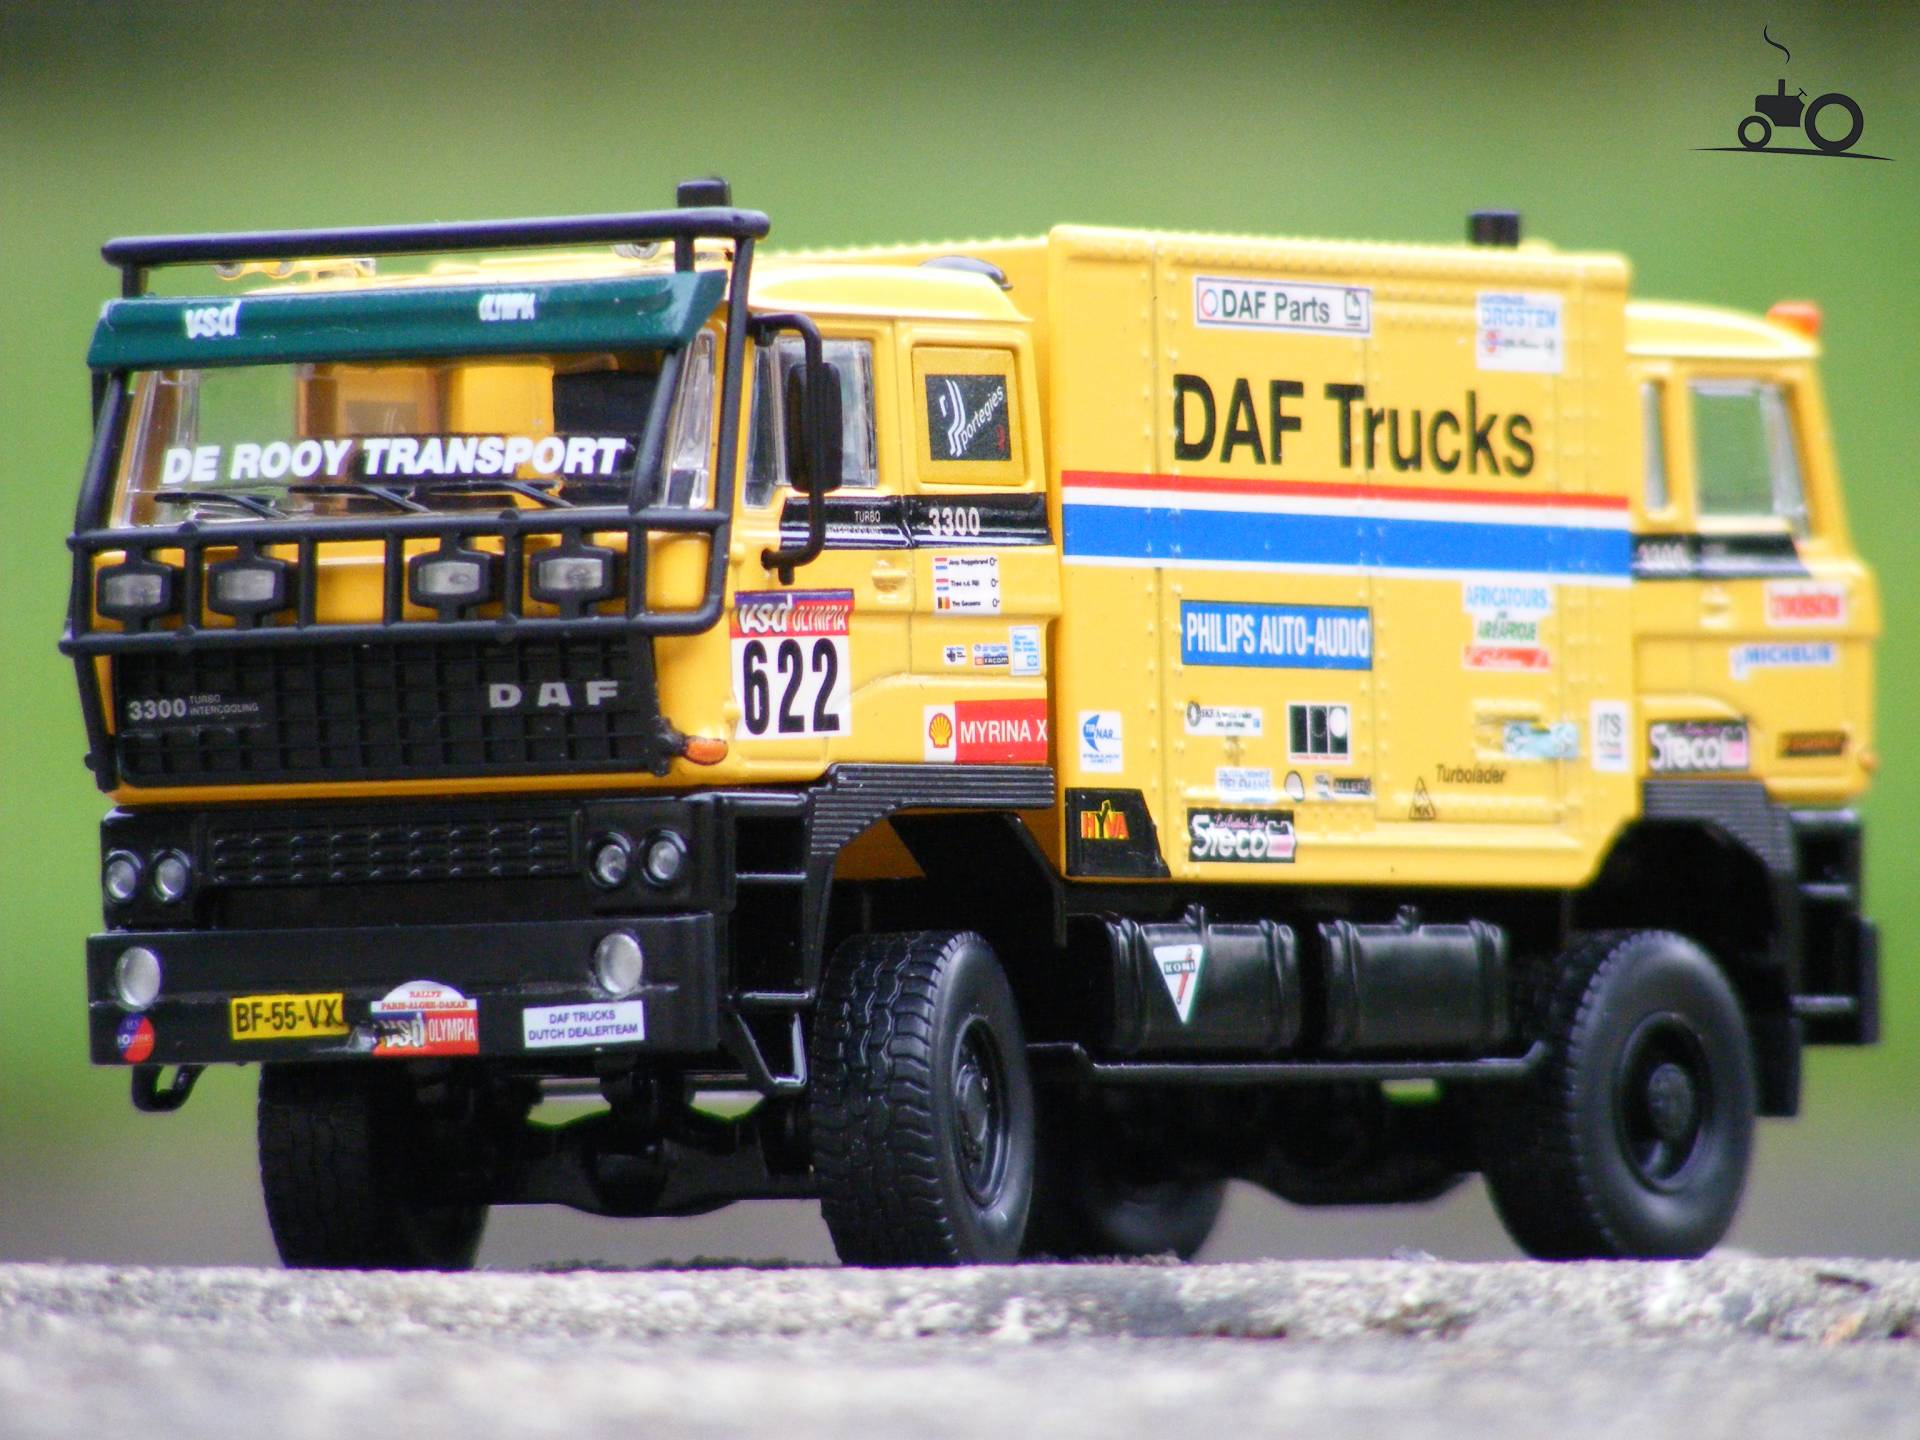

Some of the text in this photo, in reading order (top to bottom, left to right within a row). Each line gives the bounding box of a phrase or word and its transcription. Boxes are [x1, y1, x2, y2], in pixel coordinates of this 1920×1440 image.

[1222, 289, 1330, 324] DAF Parts
[1173, 373, 1536, 478] DAF Trucks
[162, 436, 627, 484] DE ROOY TRANSPORT
[854, 510, 881, 523] TURBO
[928, 507, 981, 536] 3300
[739, 594, 848, 634] vsd OLYMPIA
[1186, 612, 1371, 659] PHILIPS AUTO-AUDIO
[189, 694, 221, 703] TURBO
[489, 680, 618, 708] DAF
[743, 637, 840, 735] 622
[129, 698, 186, 720] 3300
[190, 702, 259, 716] INTERCOOLING
[960, 719, 1047, 744] MYRINA X
[1436, 763, 1506, 785] Turbolader
[1081, 800, 1129, 839] HYVA
[1192, 815, 1268, 858] Steco
[1164, 962, 1195, 974] KONI
[236, 999, 339, 1033] BF-55-VX
[428, 1018, 476, 1042] OLYMPIA
[548, 1010, 616, 1024] DAF TRUCKS
[528, 1024, 638, 1040] DUTCH DEALERTEAM
